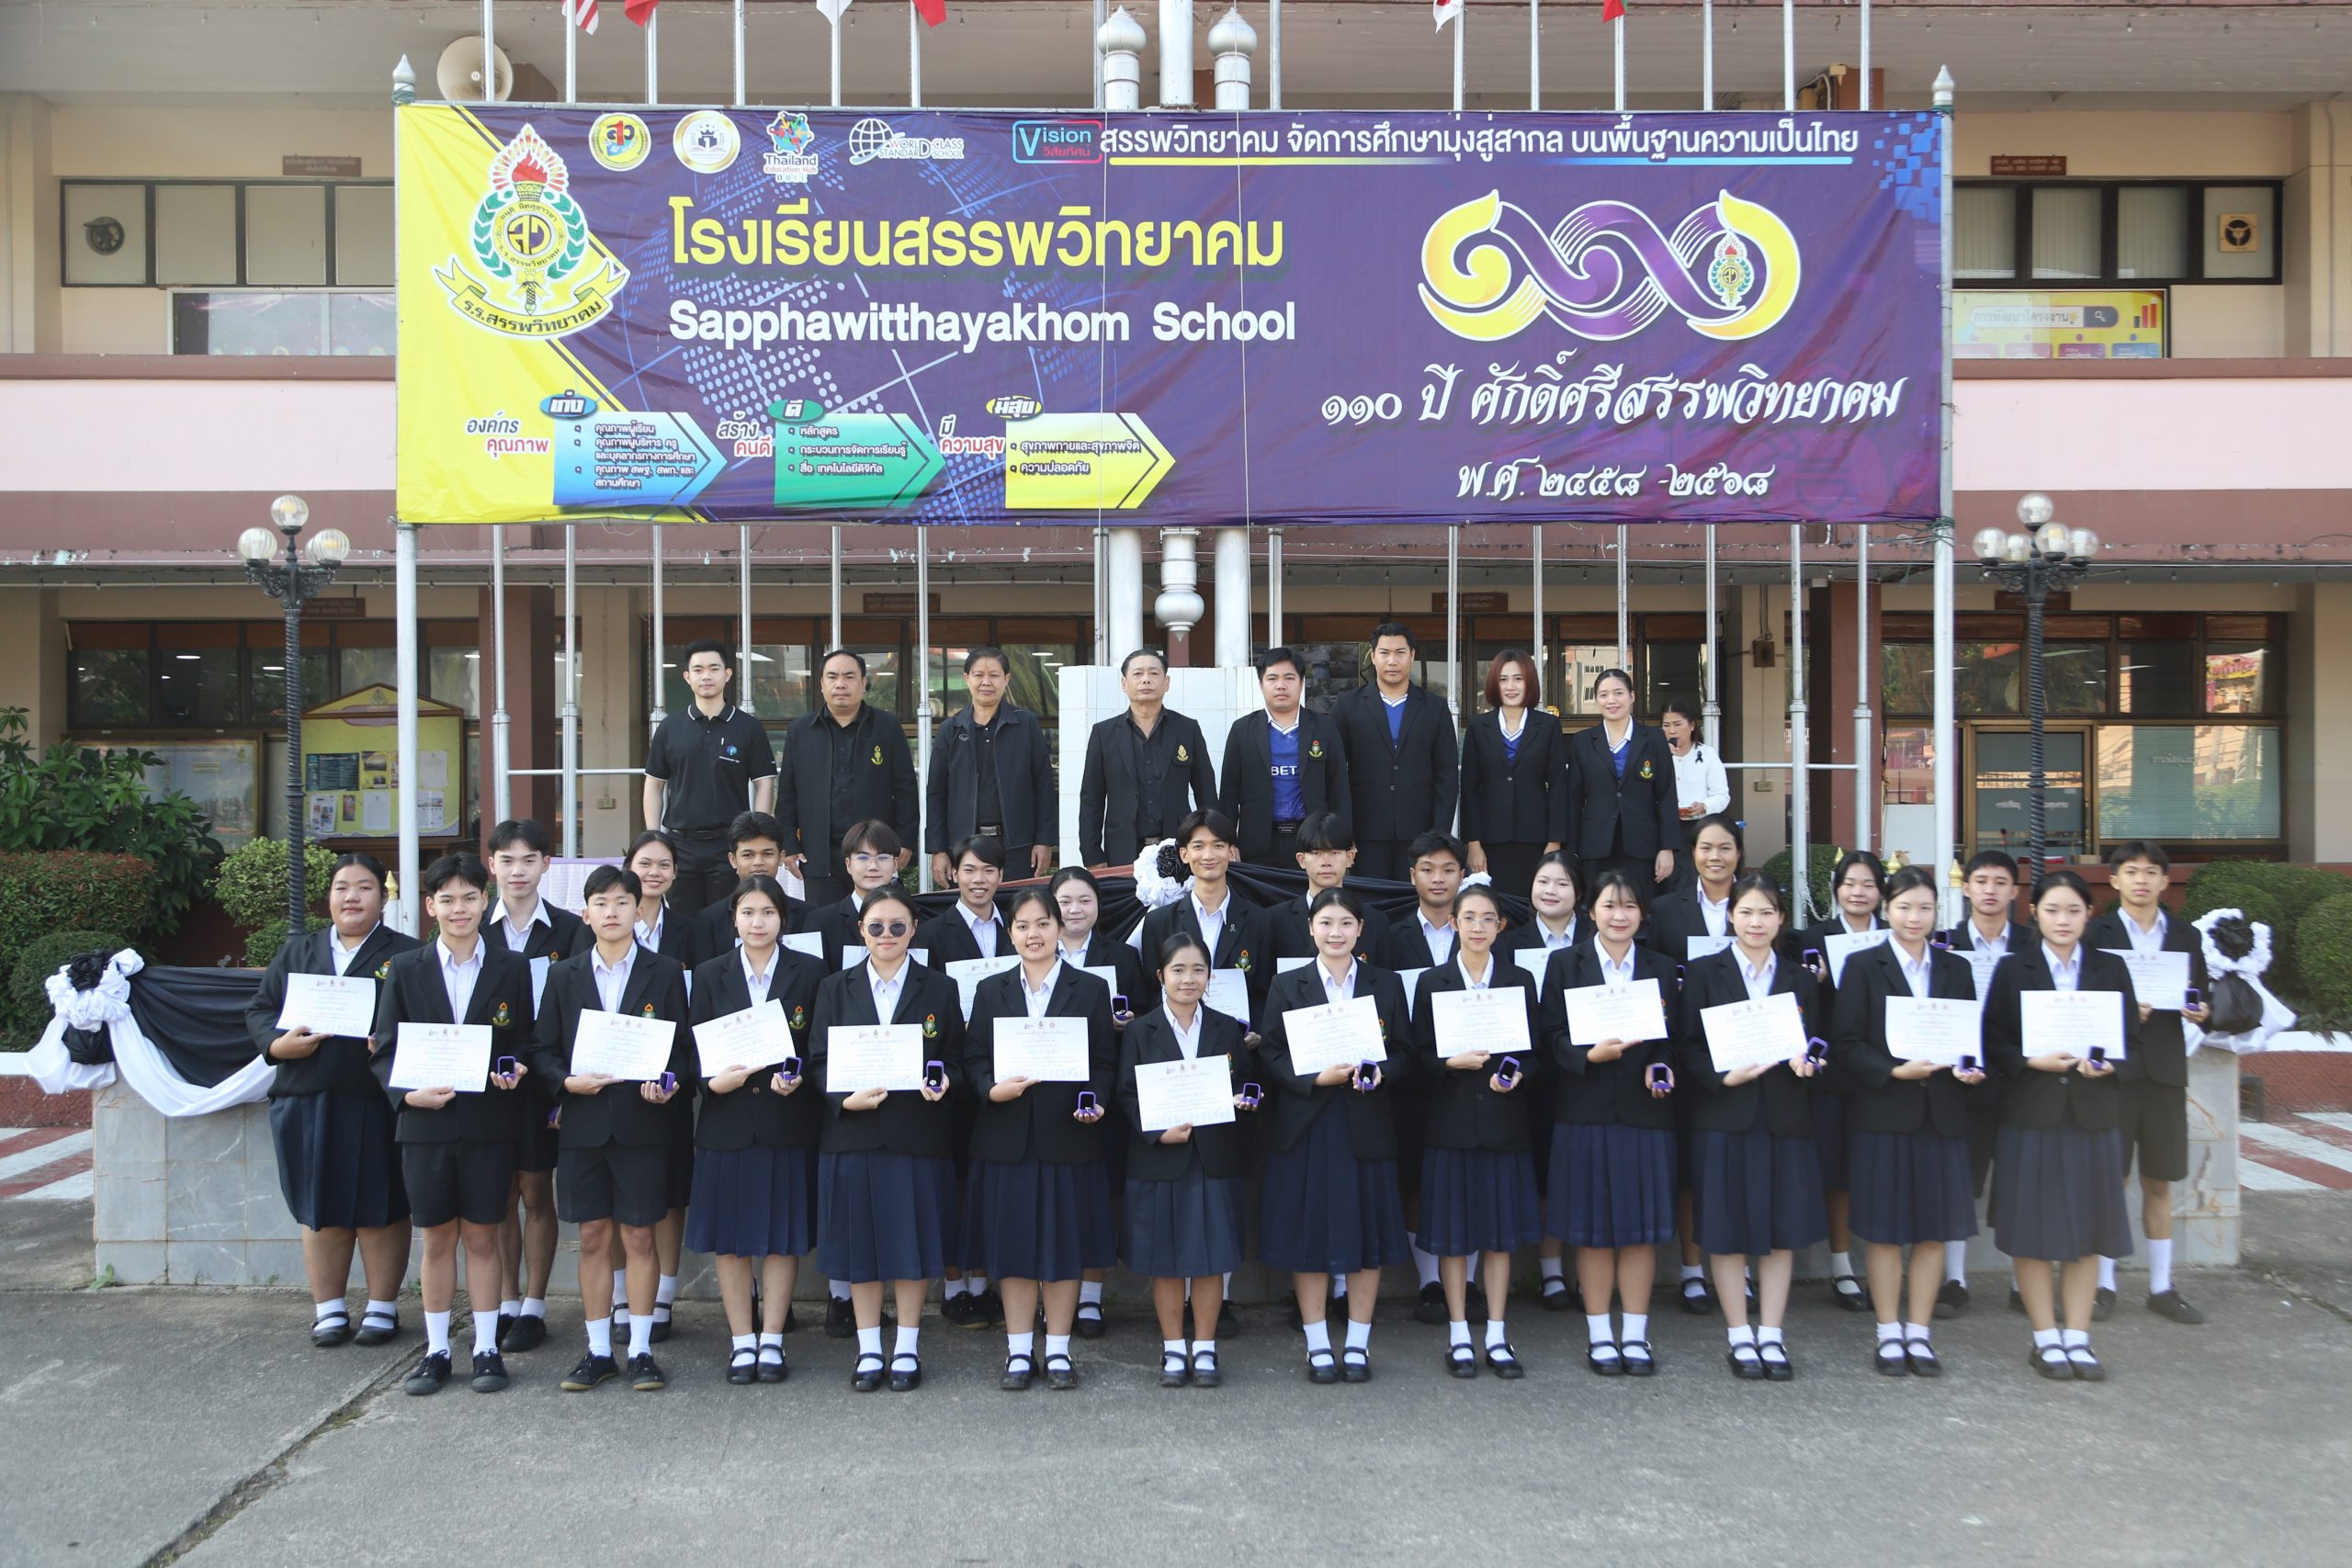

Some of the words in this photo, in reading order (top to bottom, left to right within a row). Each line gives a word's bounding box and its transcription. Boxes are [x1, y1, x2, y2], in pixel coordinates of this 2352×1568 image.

[1018, 126, 1091, 157] Vision
[1100, 124, 1279, 153] สรรพวิทยาคม
[1287, 113, 1564, 163] จัดการศึกษามุ่งสู่สากล
[1571, 114, 1859, 161] บนพื้นฐานความเป็นไทย
[765, 154, 817, 165] Thailand
[933, 149, 963, 157] SCHOOL
[669, 196, 1283, 267] โรงเรียนสรรพวิทยาคม
[464, 300, 603, 333] ร.ร.สรรพวิทยาคม
[669, 299, 1129, 354] Sapphawitthayakhom
[1152, 301, 1296, 342] School
[1321, 391, 1402, 426] ๑๑๐
[1417, 363, 1463, 423] ปี
[1471, 347, 1908, 426] ศักดิ์ศรีสรรพวิทยาคม
[467, 411, 520, 434] องค์กร
[594, 420, 655, 437] คุณภาพผู้เรียน
[718, 412, 758, 437] สร้าง
[799, 424, 838, 438] หลักสูตร
[941, 416, 955, 436] มี
[486, 438, 549, 458] คุณภาพ
[665, 439, 677, 450] ครู
[736, 437, 772, 456] คนดี
[799, 441, 907, 457] กระบวนการจัดการเรียนรู้
[942, 438, 1004, 458] ความสุข
[1021, 441, 1140, 454] สุขภาพกายและสุขภาพจิต
[595, 450, 696, 462] และบุคลากรทางการศึกษา
[594, 465, 629, 476] คุณภาพ
[680, 466, 695, 475] และ
[799, 460, 813, 473] สื่อ
[1021, 462, 1090, 473] ความปลอดภัย
[594, 477, 641, 488] สถานศึกษา
[1535, 464, 1647, 498] ๒๔๕๘
